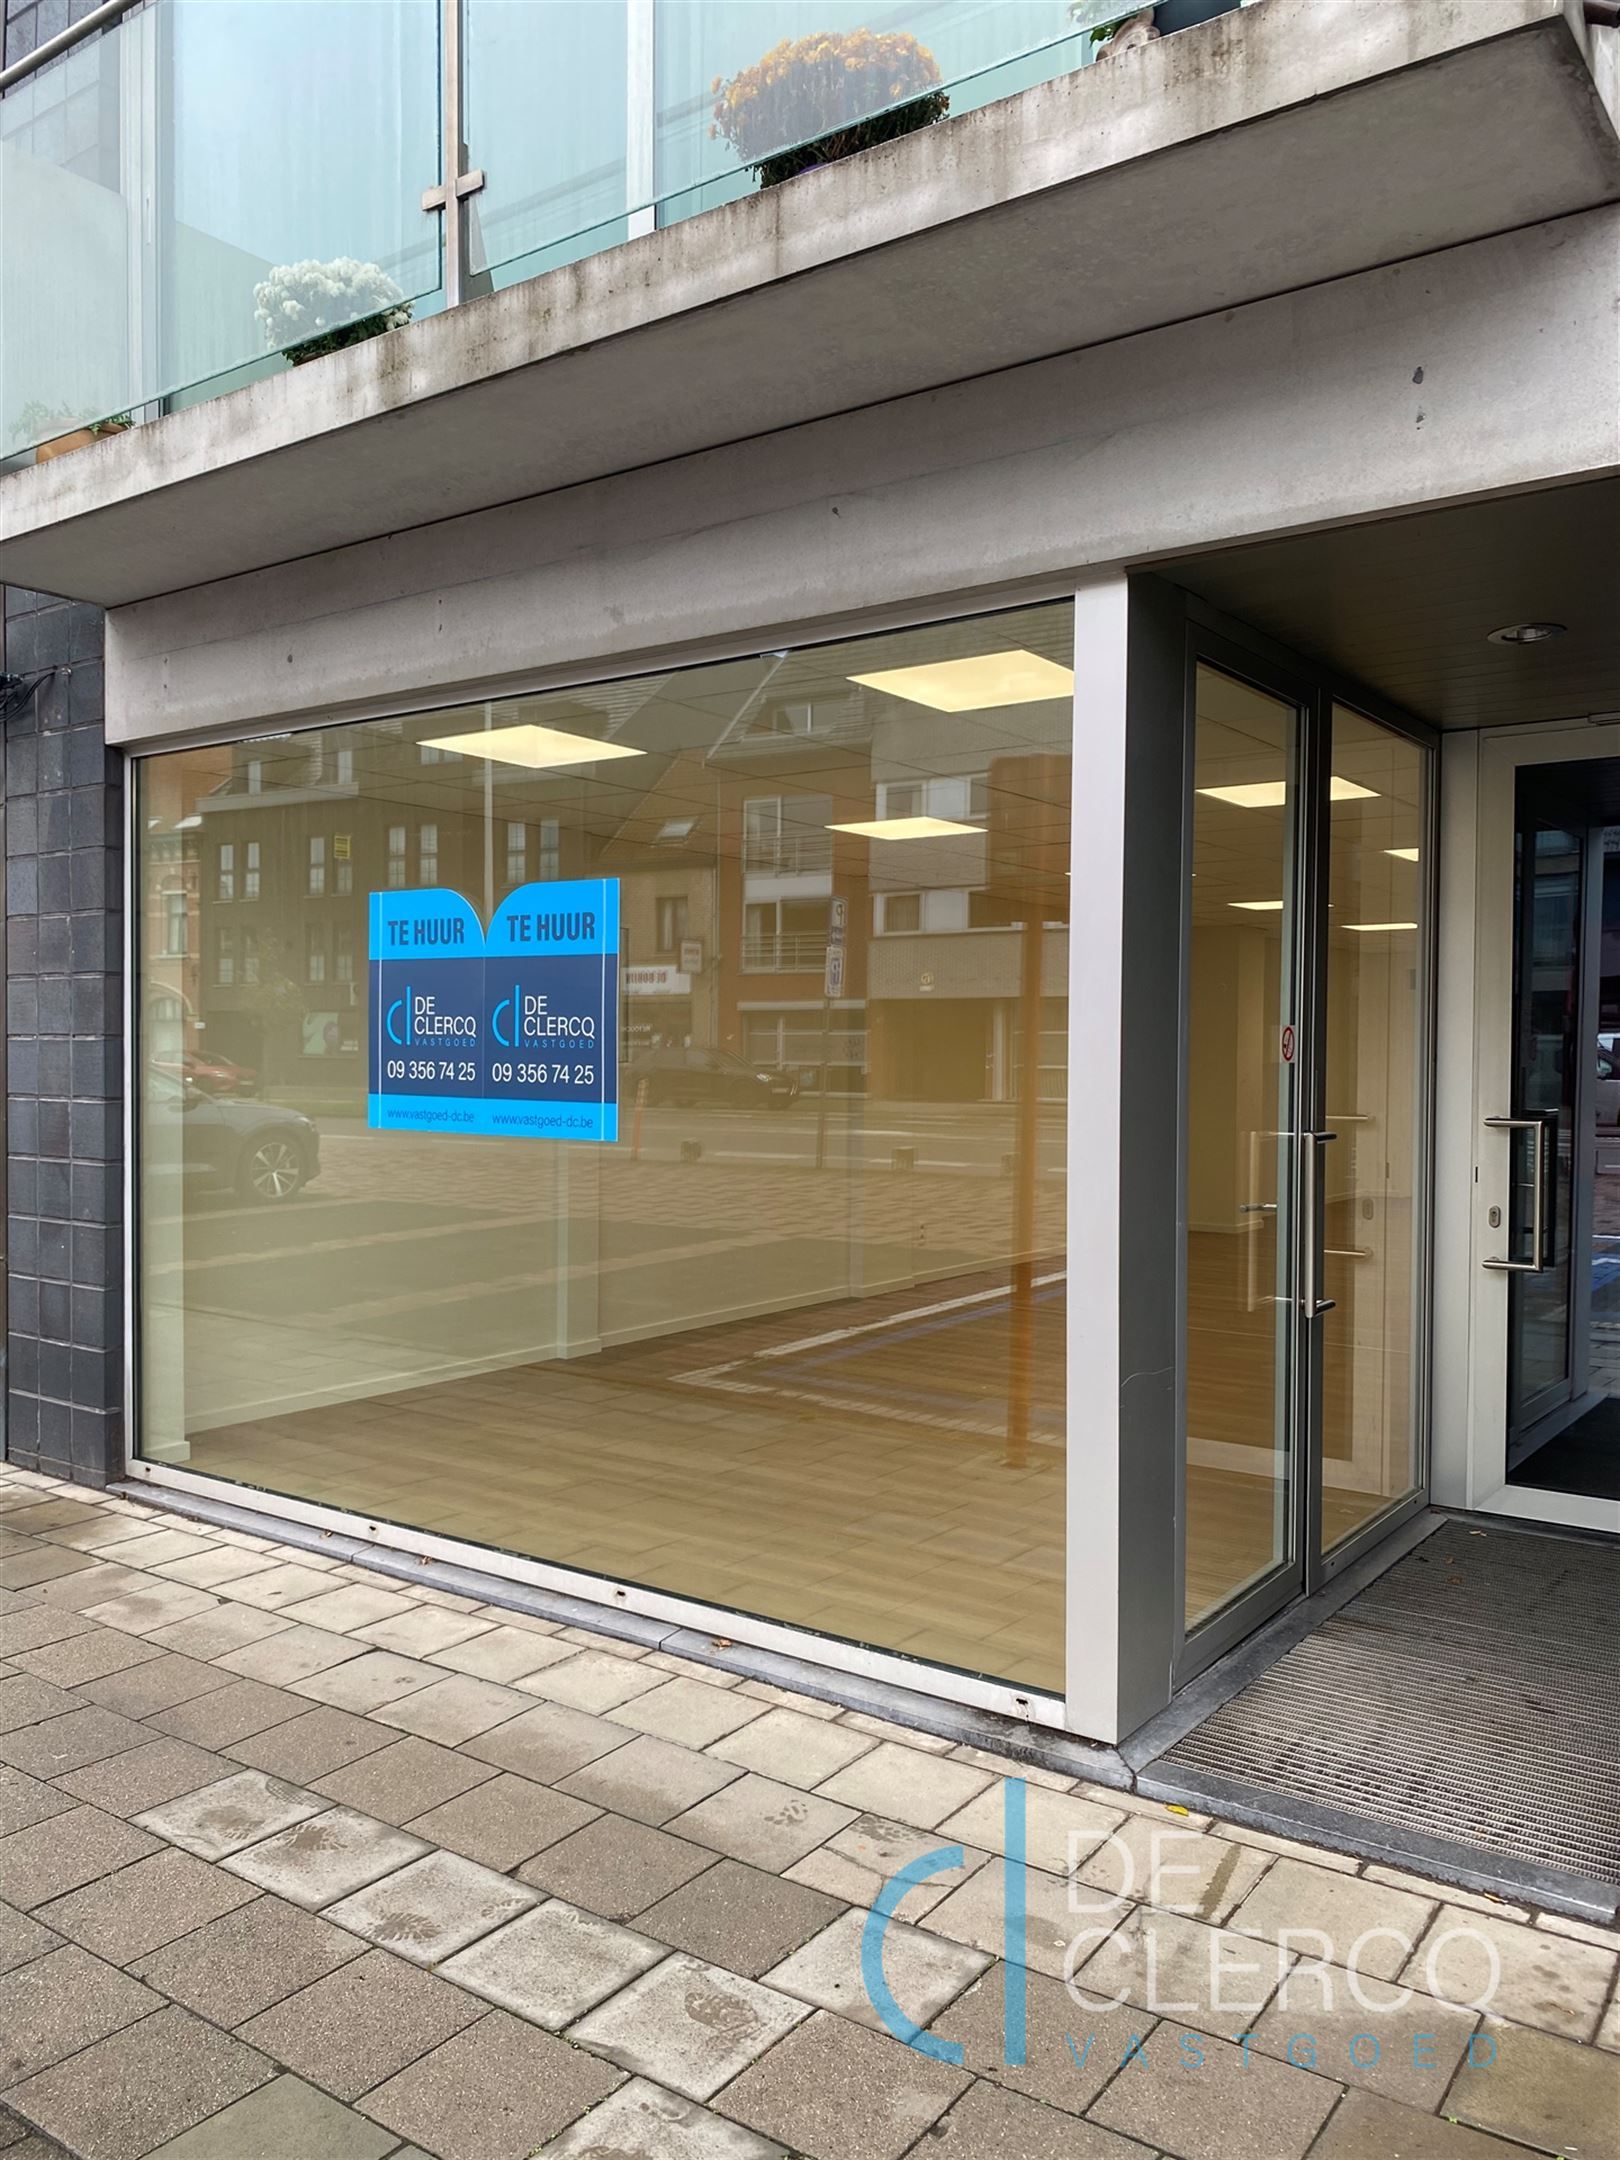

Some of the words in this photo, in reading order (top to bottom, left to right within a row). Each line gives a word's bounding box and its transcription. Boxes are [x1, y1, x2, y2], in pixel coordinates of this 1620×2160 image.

[387, 920, 409, 946] TE
[413, 917, 465, 945] HUUR
[506, 915, 531, 942] TE
[536, 912, 595, 941] HUUR
[414, 996, 436, 1015] DE
[524, 995, 548, 1015] DE
[414, 1016, 477, 1038] CLERCQ
[523, 1016, 596, 1039] CLERCQ
[414, 1037, 477, 1047] VASTGOED
[524, 1039, 594, 1049] VASTGOED
[387, 1060, 405, 1078] 09
[408, 1061, 436, 1080] 356
[439, 1062, 455, 1080] 74
[458, 1062, 476, 1081] 25
[492, 1062, 513, 1082] 09
[516, 1063, 548, 1083] 356
[551, 1064, 570, 1083] 74
[574, 1064, 595, 1085] 25
[386, 1109, 475, 1123] www.vastgoed-dc.be
[492, 1114, 594, 1129] www.vastgoed-dc.be
